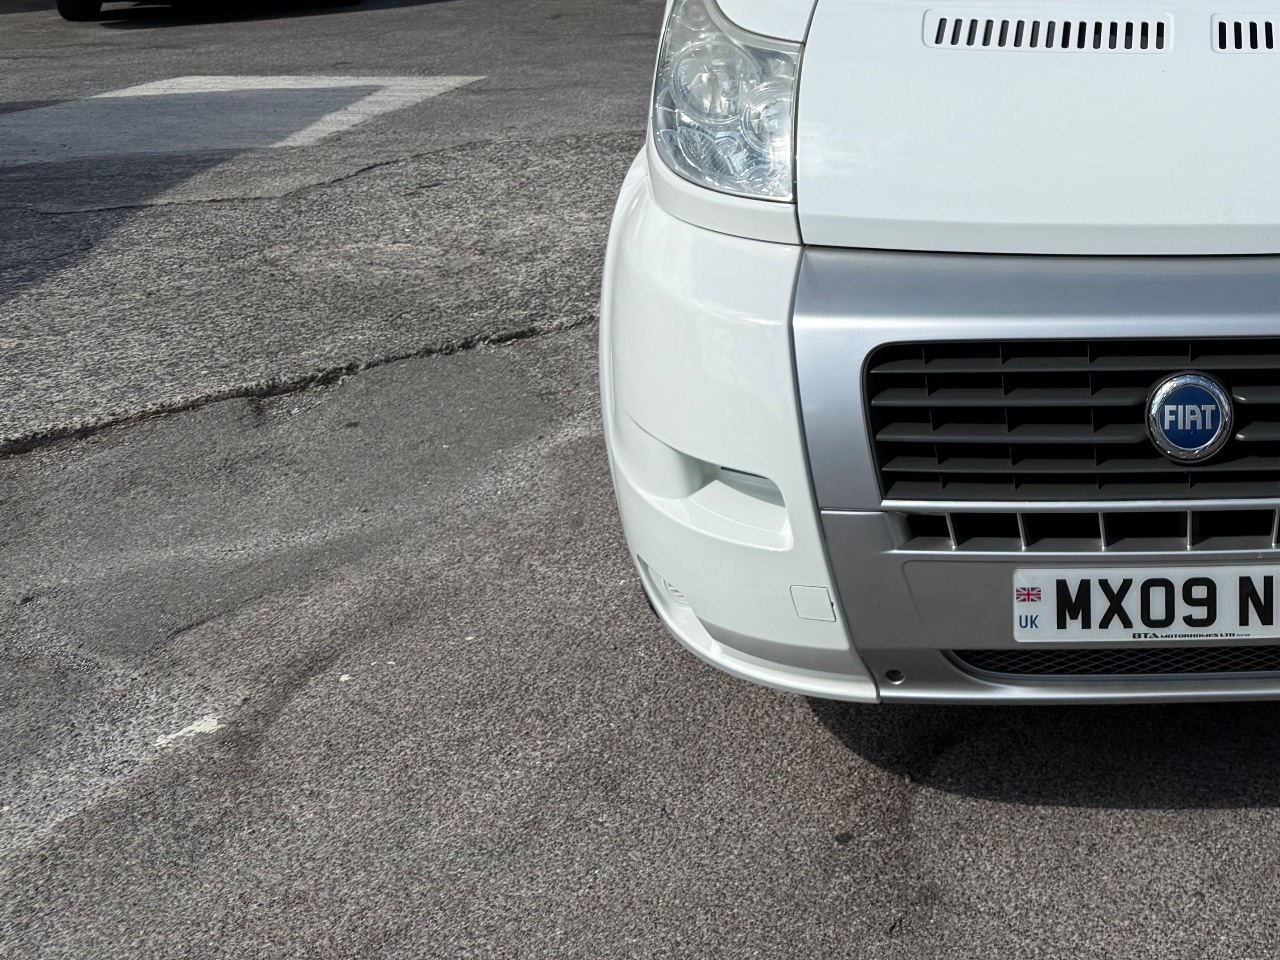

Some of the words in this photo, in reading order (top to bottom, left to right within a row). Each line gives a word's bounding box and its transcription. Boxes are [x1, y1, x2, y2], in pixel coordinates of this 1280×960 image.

[1164, 404, 1216, 430] FIAT
[1055, 576, 1217, 630] MX09
[1018, 614, 1039, 629] UK
